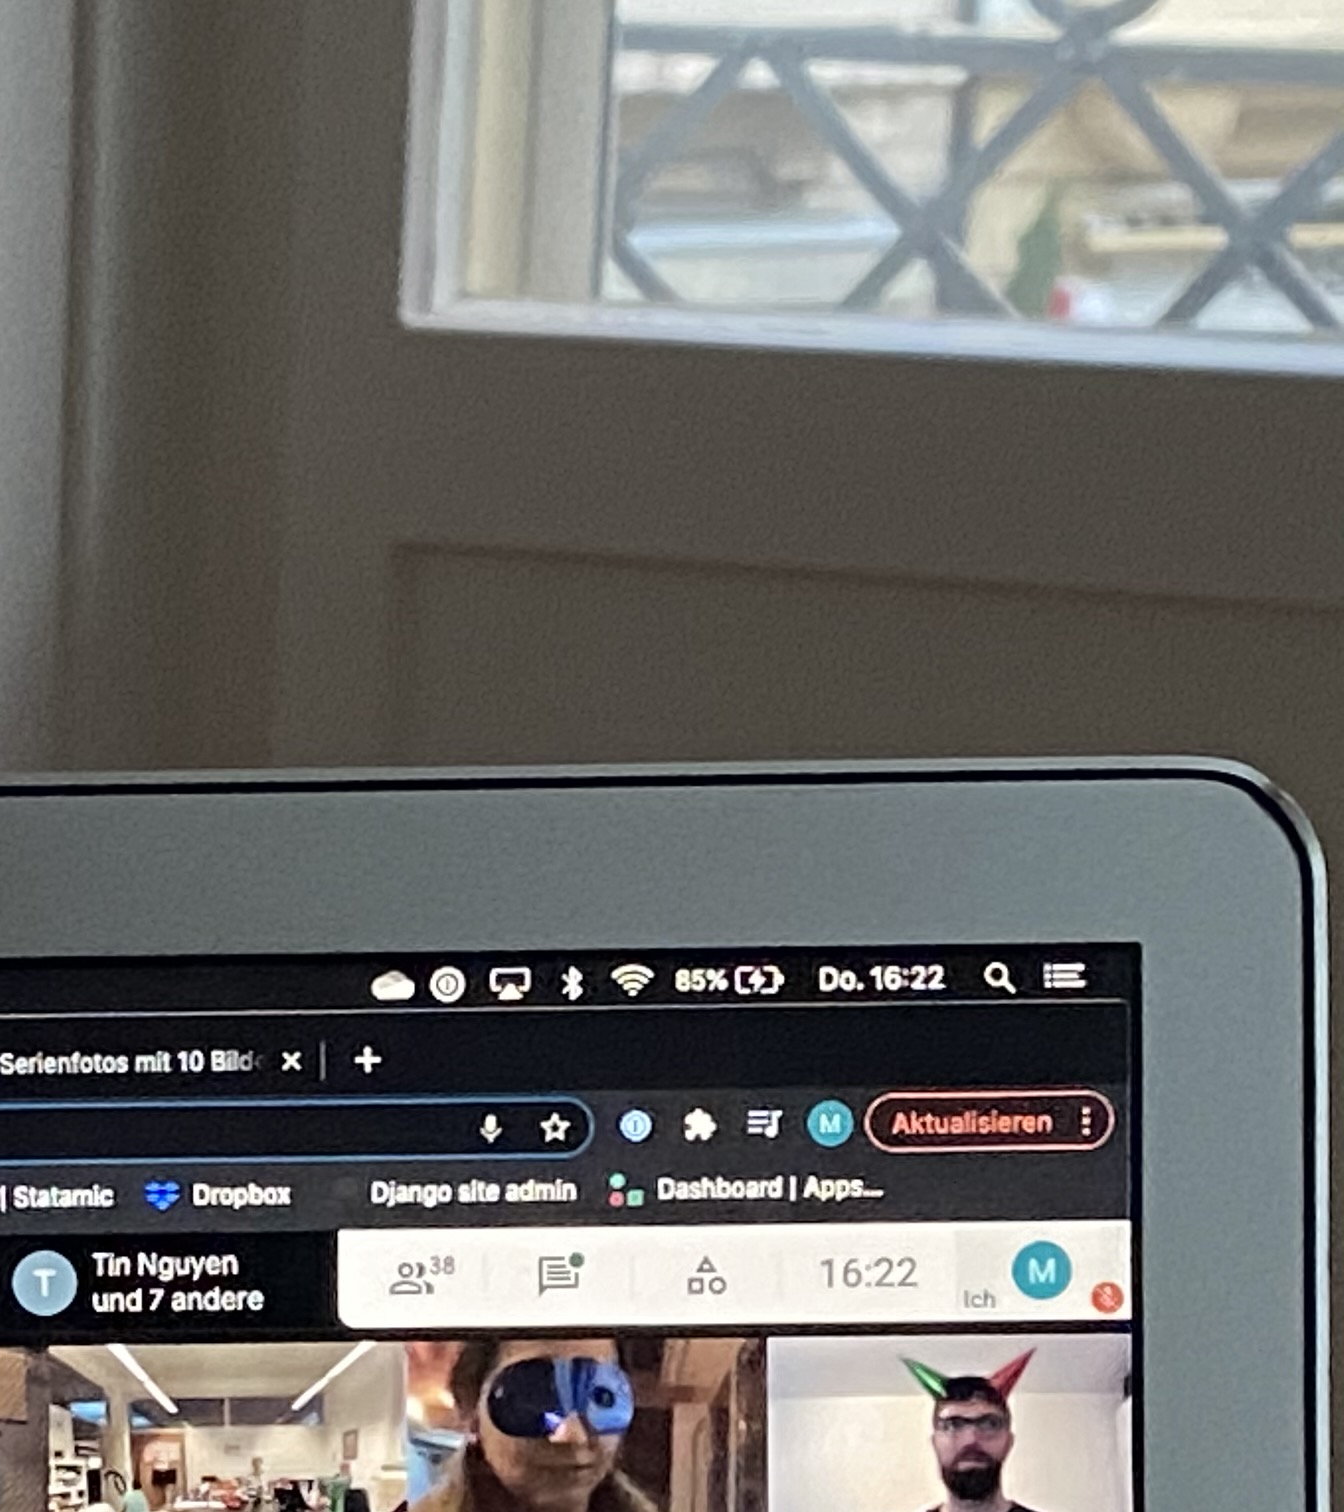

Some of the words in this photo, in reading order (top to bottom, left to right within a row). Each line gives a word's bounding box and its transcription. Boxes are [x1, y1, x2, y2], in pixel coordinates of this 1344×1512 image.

[675, 969, 726, 992] 85%
[819, 967, 864, 992] Do.
[870, 966, 945, 991] 16:22
[0, 1051, 128, 1074] Serienfotos
[134, 1051, 171, 1073] mit
[177, 1050, 204, 1072] 10
[891, 1109, 1053, 1136] Aktualisieren
[13, 1185, 115, 1208] Statamic
[193, 1184, 291, 1209] Dropbox
[371, 1180, 453, 1208] Django
[458, 1179, 500, 1202] site
[506, 1177, 577, 1202] admin
[657, 1176, 783, 1201] Dashboard
[91, 1252, 130, 1277] Tin
[138, 1253, 238, 1282] Nguyen
[430, 1255, 455, 1275] 38
[820, 1257, 917, 1289] 16:22
[1028, 1259, 1055, 1284] M
[33, 1268, 56, 1297] T
[92, 1288, 142, 1312] und
[150, 1289, 164, 1311] 7
[171, 1286, 264, 1311] andere
